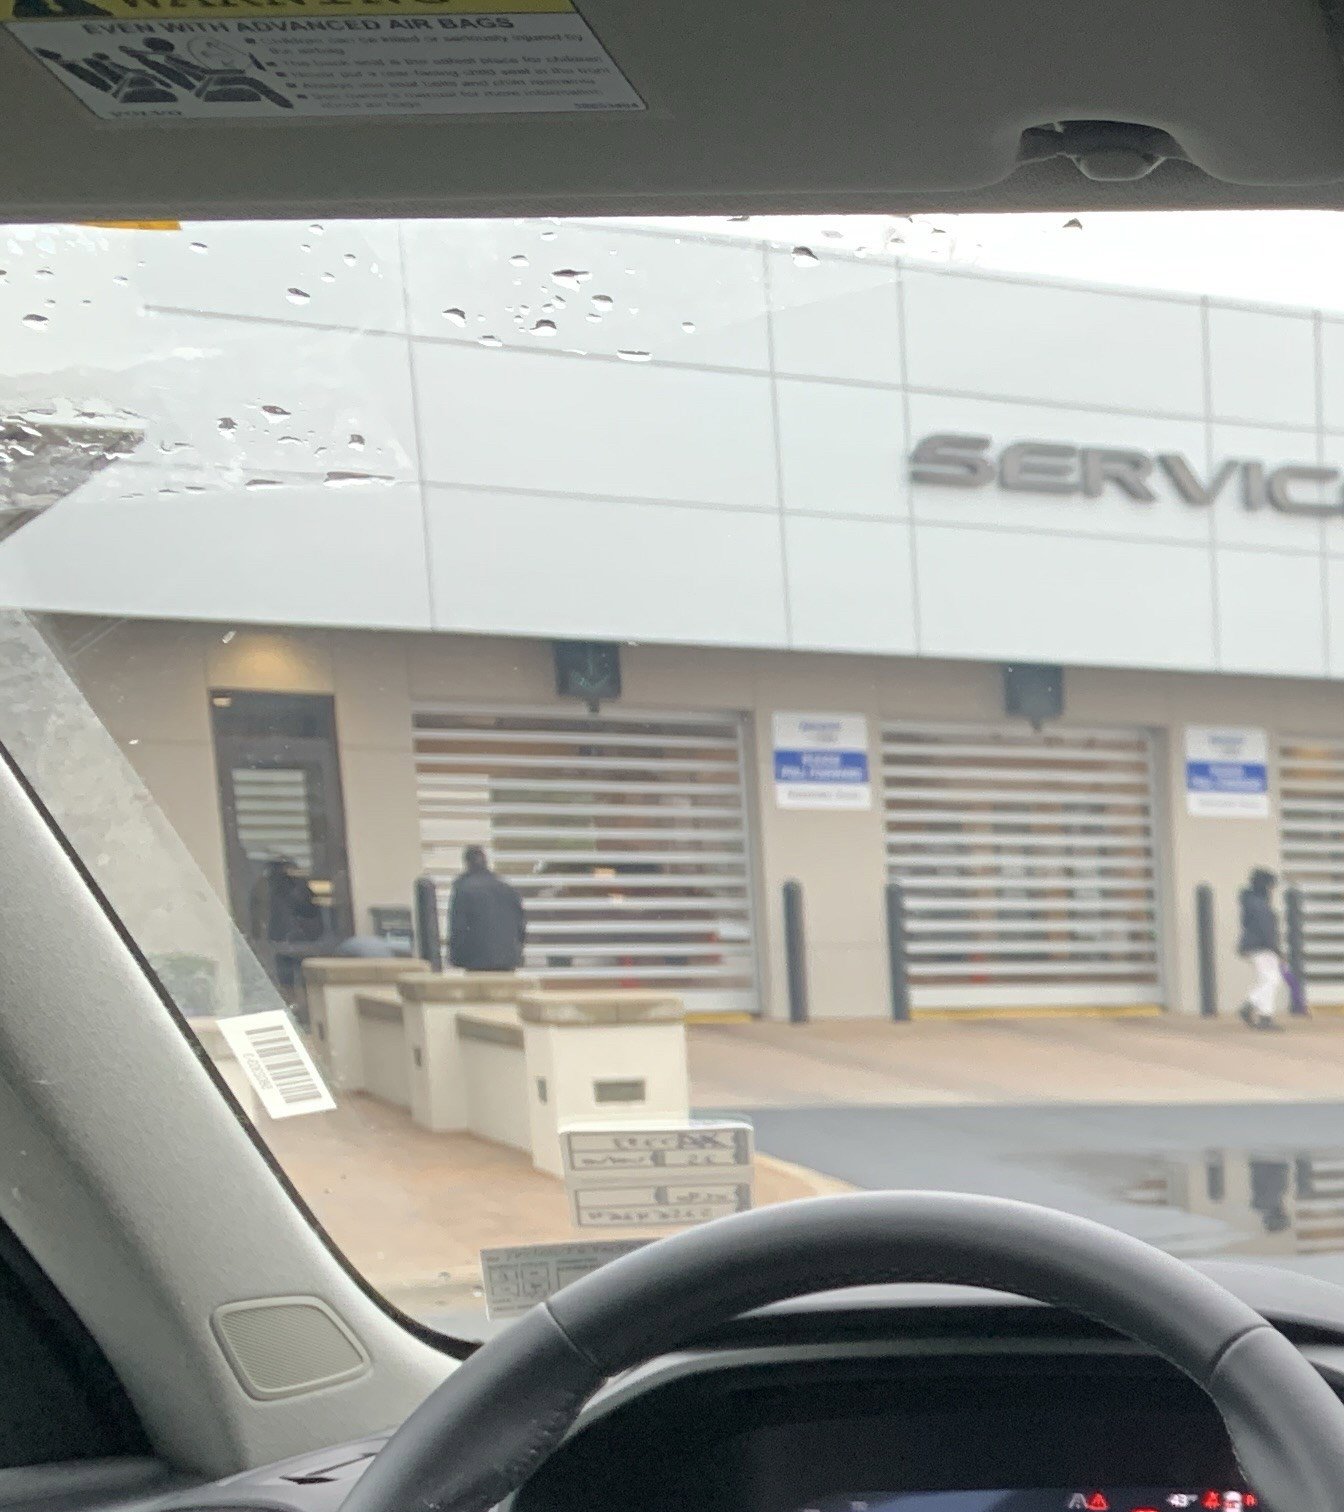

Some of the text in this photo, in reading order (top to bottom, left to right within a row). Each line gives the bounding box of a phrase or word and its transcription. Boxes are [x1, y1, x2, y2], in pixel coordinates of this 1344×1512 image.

[82, 17, 515, 34] EVEN WITH ADVANCED AIR BAGS
